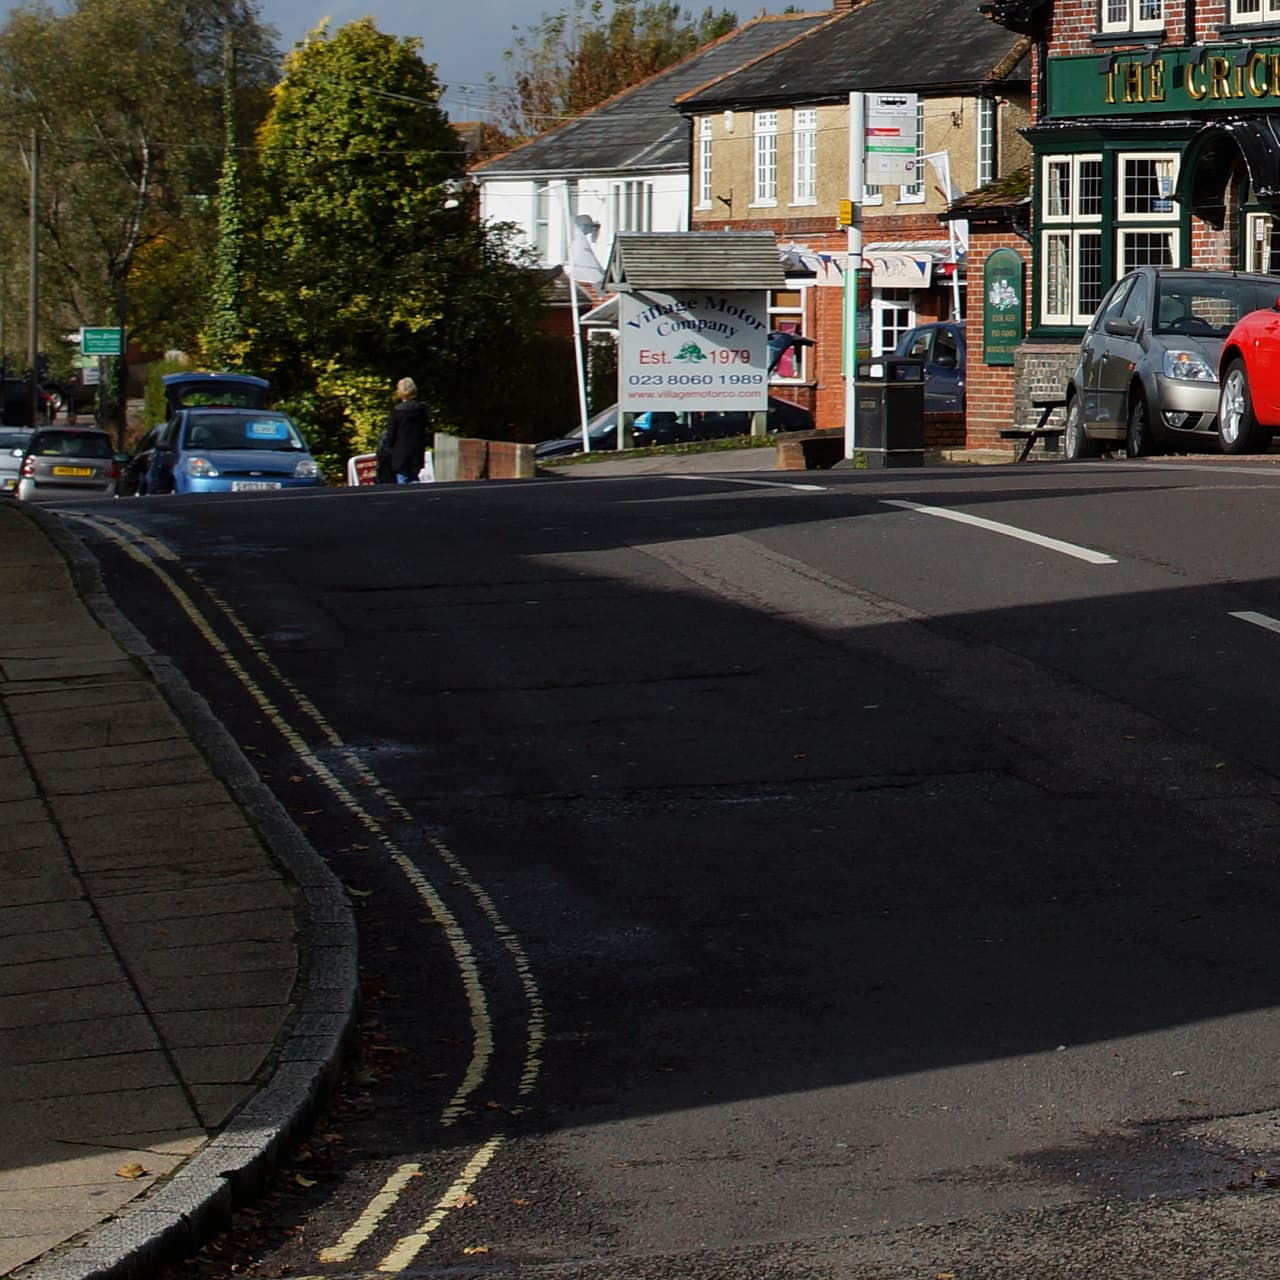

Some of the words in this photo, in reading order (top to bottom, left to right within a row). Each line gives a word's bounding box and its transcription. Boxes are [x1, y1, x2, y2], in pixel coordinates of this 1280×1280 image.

[1104, 59, 1165, 104] THE
[626, 298, 698, 330] Village
[705, 295, 766, 331] Motor
[656, 317, 740, 339] Company
[639, 349, 672, 365] Est.
[709, 349, 751, 365] 1979
[628, 375, 663, 386] 023
[667, 375, 713, 386] 8060
[719, 375, 764, 385] 1989
[628, 389, 761, 400] www.villagemotorco.com
